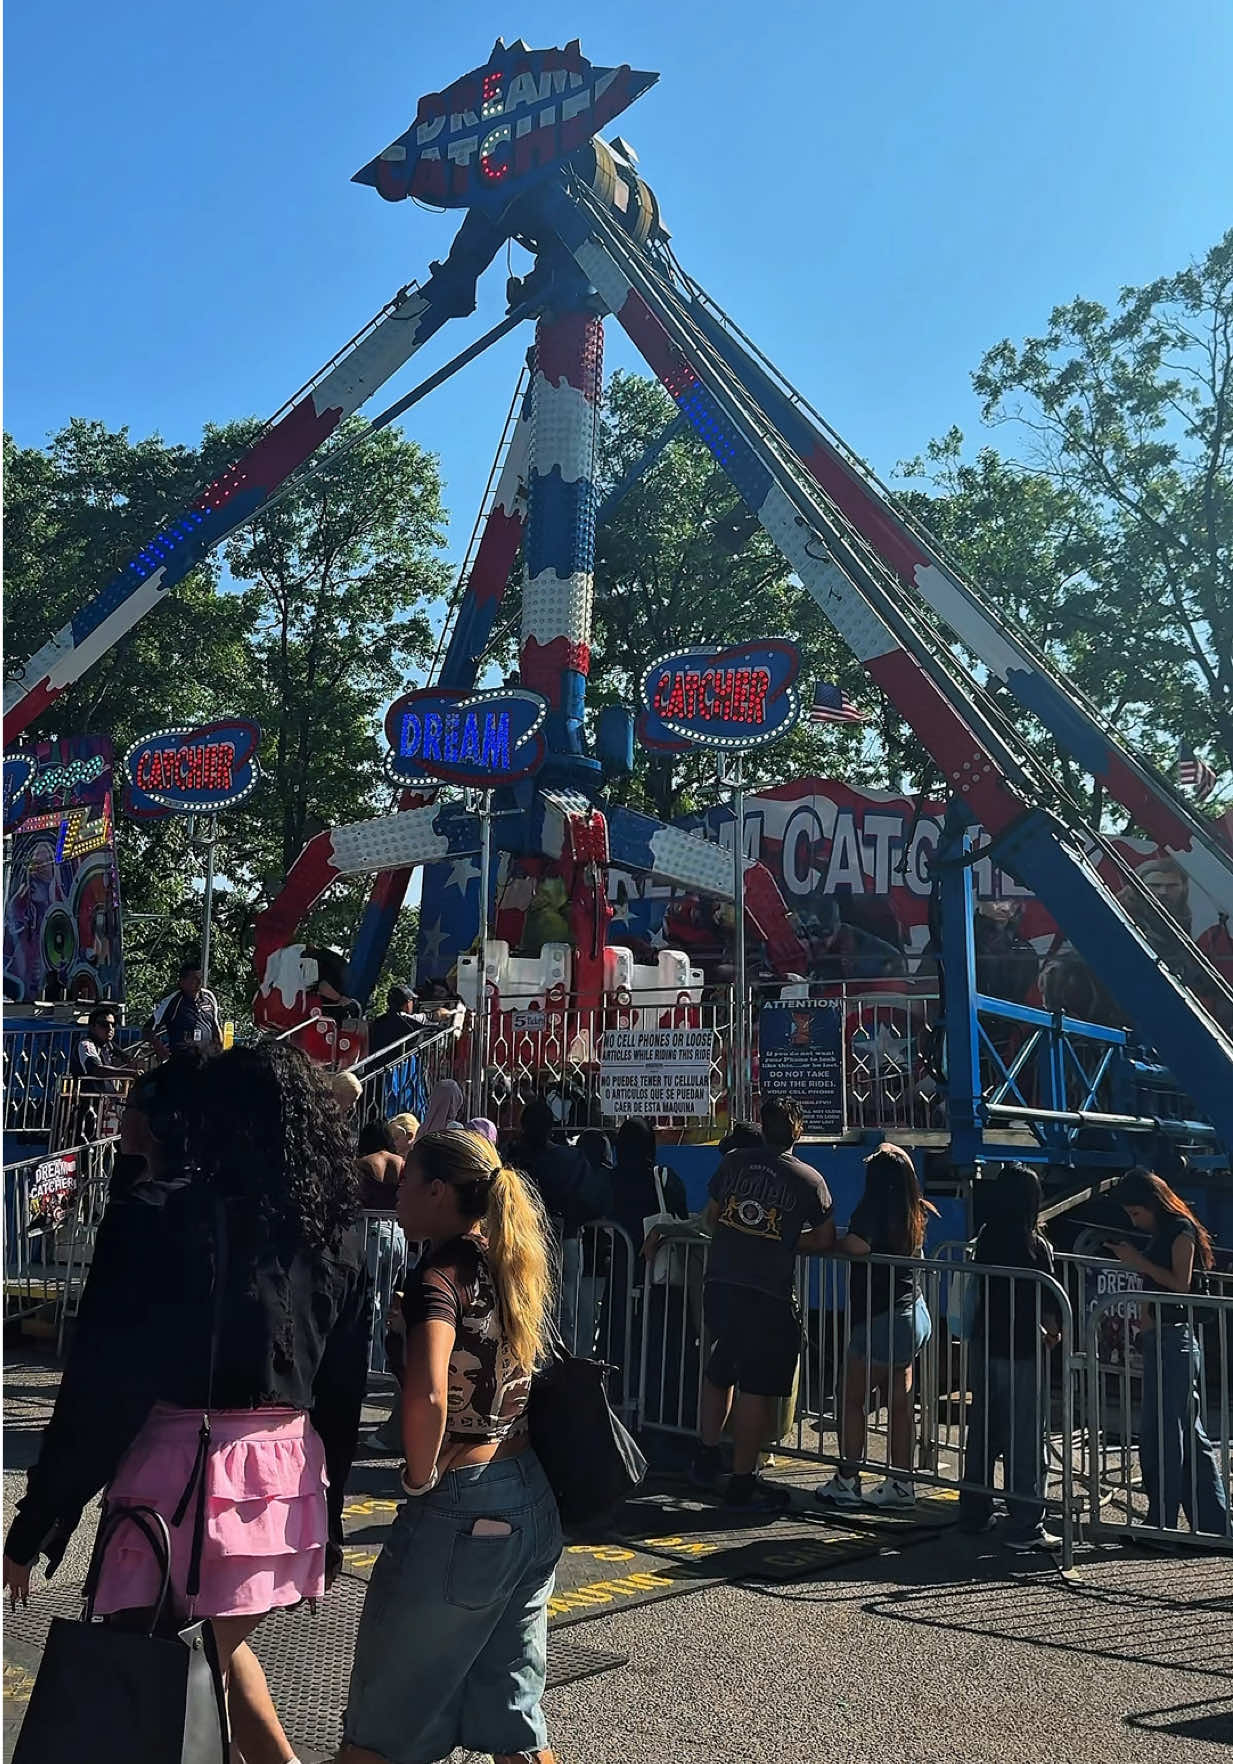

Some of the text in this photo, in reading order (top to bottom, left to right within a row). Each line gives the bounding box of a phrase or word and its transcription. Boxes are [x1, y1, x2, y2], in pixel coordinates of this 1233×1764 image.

[416, 57, 585, 145] DREAM
[654, 665, 771, 724] CATCHER
[400, 712, 511, 770] DREAM
[136, 741, 236, 791] CATCHER
[763, 999, 840, 1009] ATTENTION
[604, 1032, 713, 1048] NO CELL PHONES OR LOOSE
[603, 1048, 711, 1061] ARTICLES WHILE RIDING THIS RIDE
[769, 1070, 831, 1078] DO NOT TAKE
[601, 1075, 710, 1087] NO PUEDES TENER TU CELLULAR
[763, 1080, 771, 1088] IT
[773, 1080, 787, 1088] ON
[789, 1080, 807, 1088] THE
[605, 1088, 705, 1100] O ARTICULOS QUE SE PUEDAN
[614, 1101, 695, 1114] CAER DE ESTA MAQUINA
[30, 1177, 75, 1198] CATCHER
